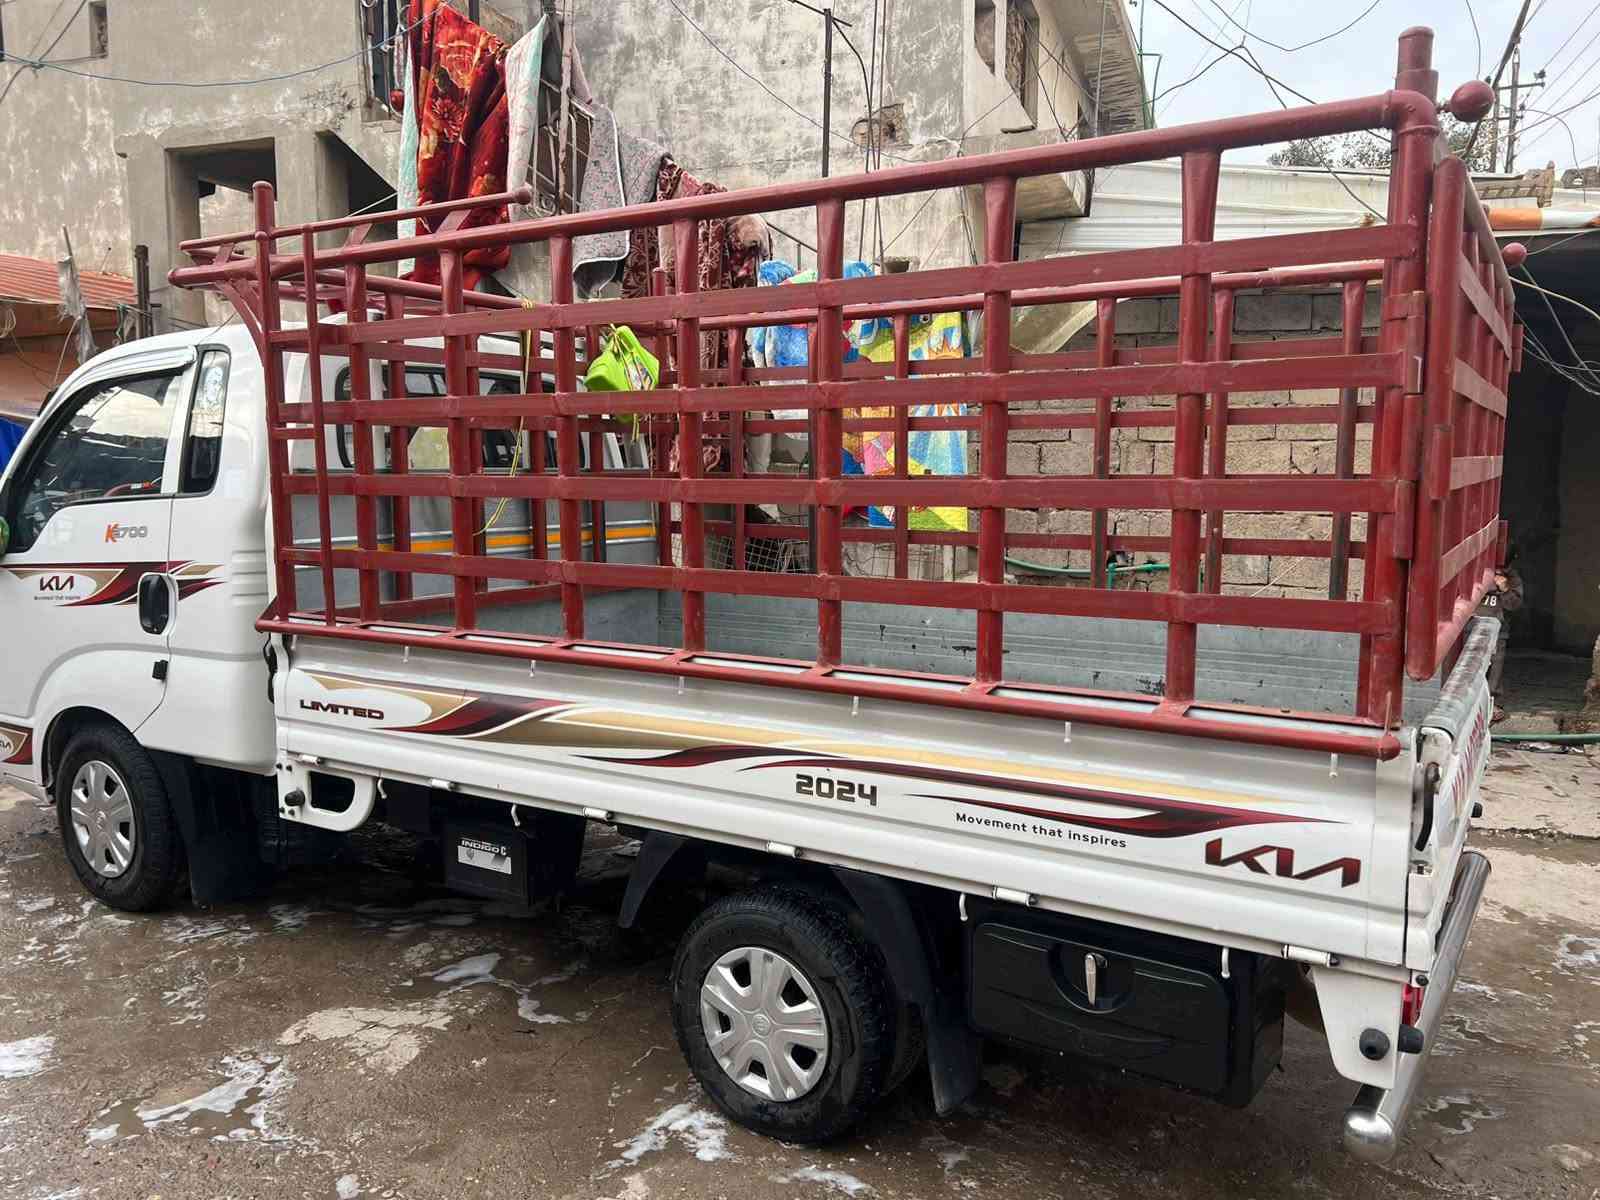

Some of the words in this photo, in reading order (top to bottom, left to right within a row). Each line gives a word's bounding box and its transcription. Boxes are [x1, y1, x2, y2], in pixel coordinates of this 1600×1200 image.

[40, 576, 74, 591] KIA
[299, 699, 384, 720] LIMITED
[796, 774, 877, 806] 2024
[955, 812, 1027, 832] Movement
[1032, 824, 1063, 838] that
[1068, 830, 1127, 848] inspires
[1205, 838, 1361, 888] KIA
